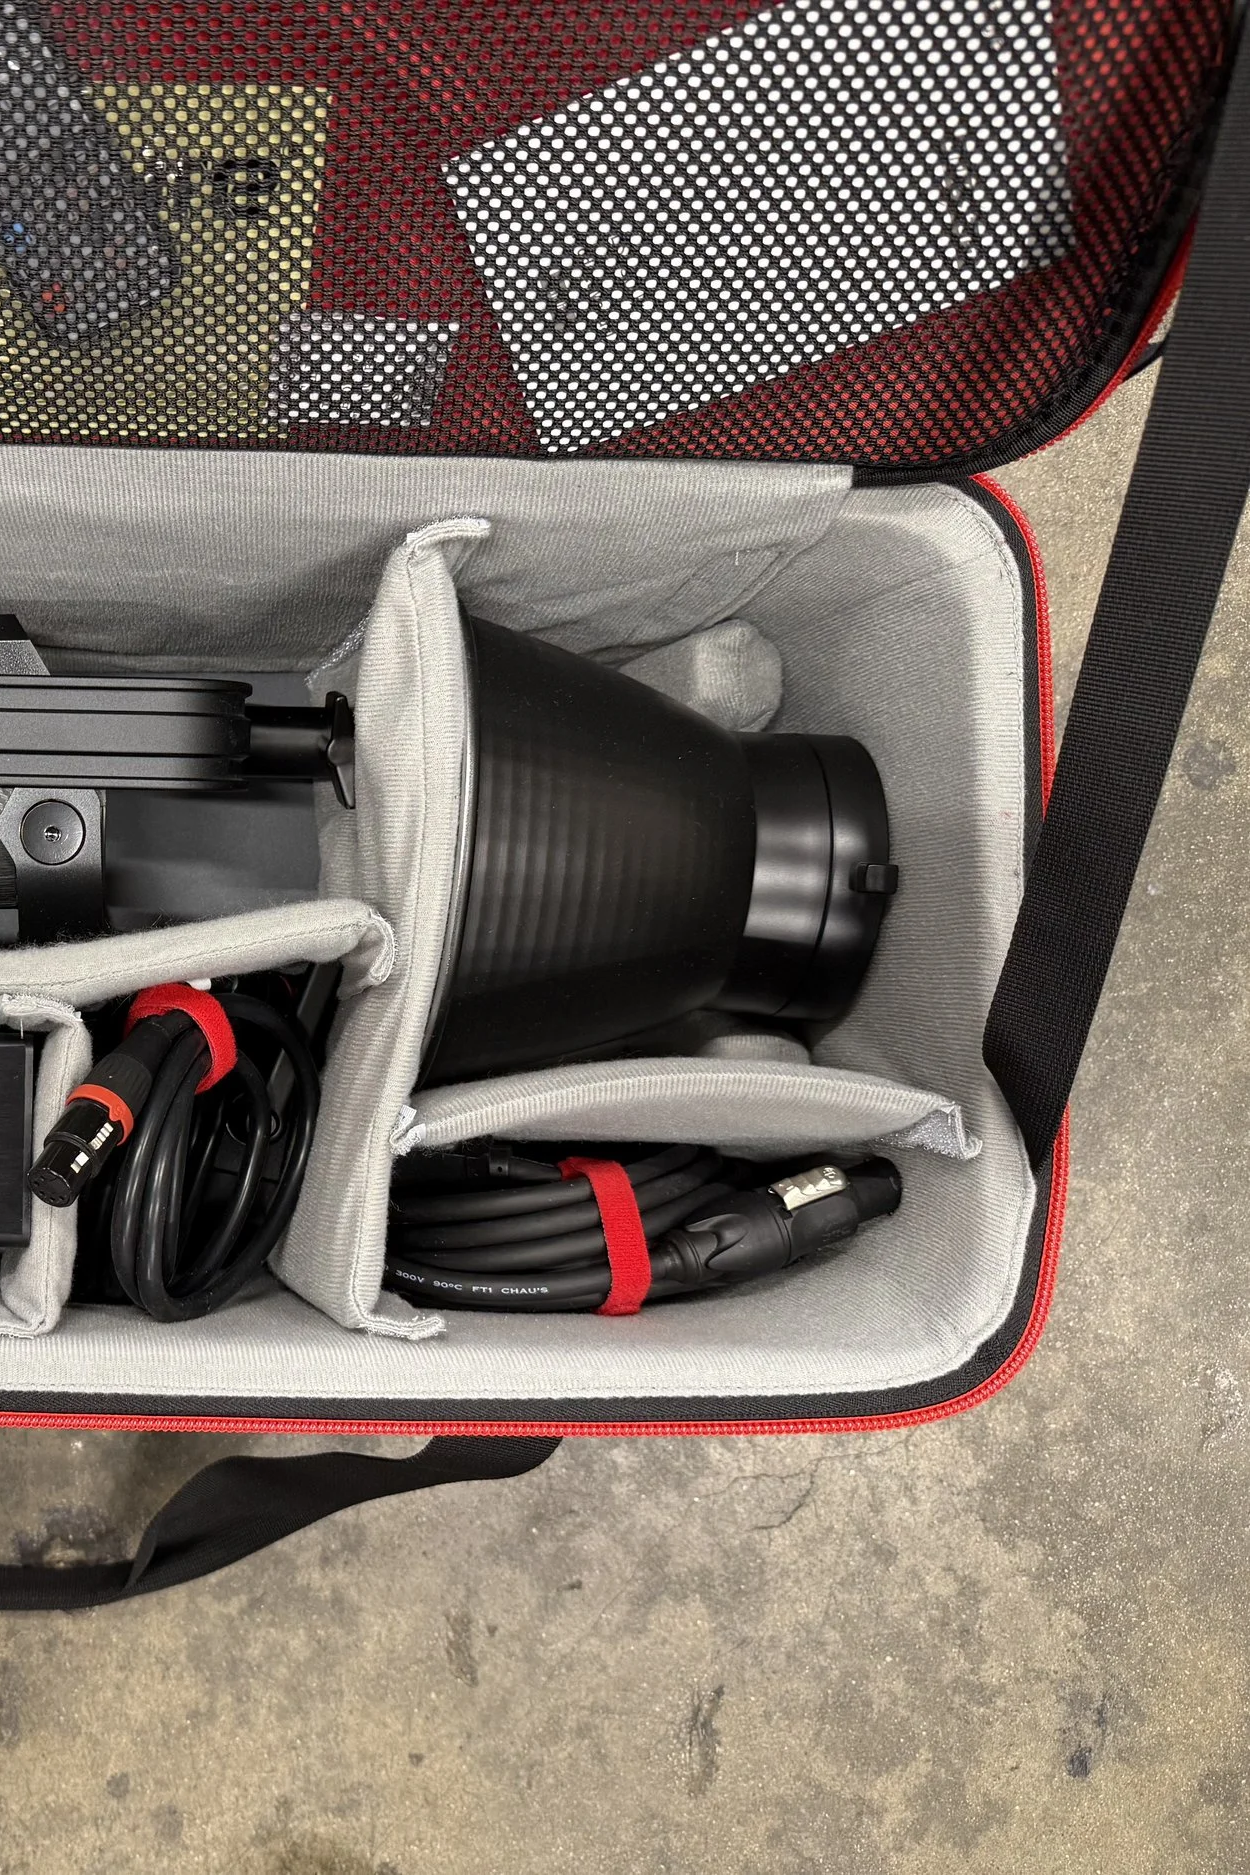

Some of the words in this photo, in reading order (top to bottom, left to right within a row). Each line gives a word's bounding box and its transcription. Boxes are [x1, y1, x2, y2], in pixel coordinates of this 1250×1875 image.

[395, 1269, 425, 1283] 300V
[471, 1285, 493, 1294] FT1
[500, 1286, 549, 1295] CHAU'S
